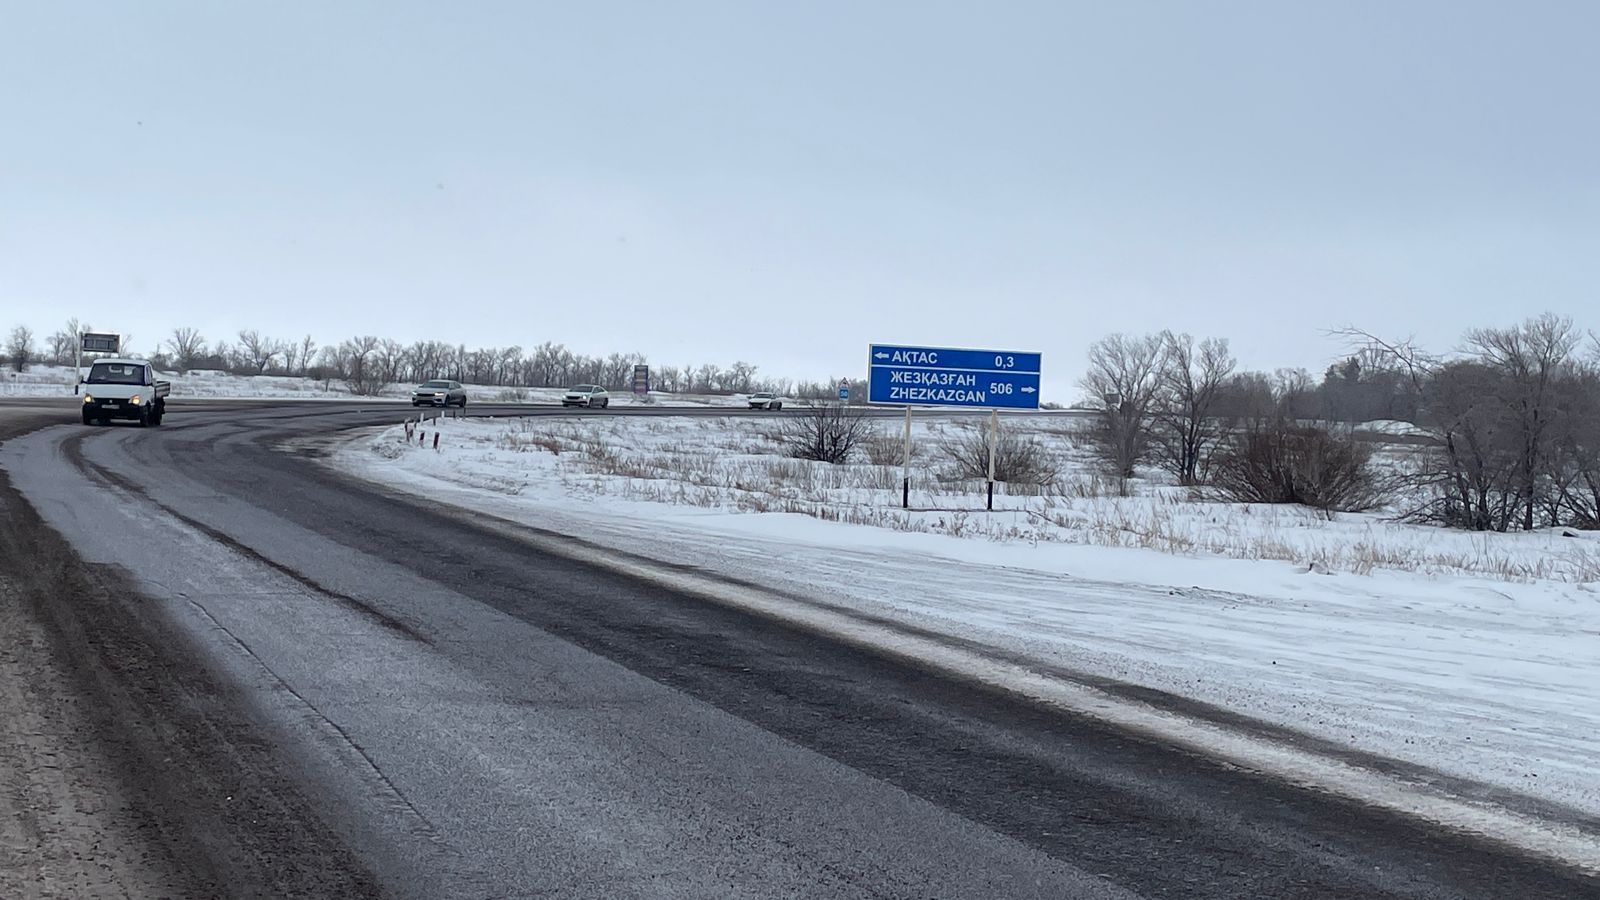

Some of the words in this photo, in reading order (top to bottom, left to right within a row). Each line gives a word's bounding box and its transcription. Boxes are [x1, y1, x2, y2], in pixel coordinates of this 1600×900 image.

[891, 350, 938, 365] АҚТАС
[995, 355, 1014, 369] 0,3
[890, 371, 976, 386] ЖЕЗҚАЗҒАН
[890, 387, 986, 403] ZHEZKAZGAN
[990, 383, 1013, 395] 506
